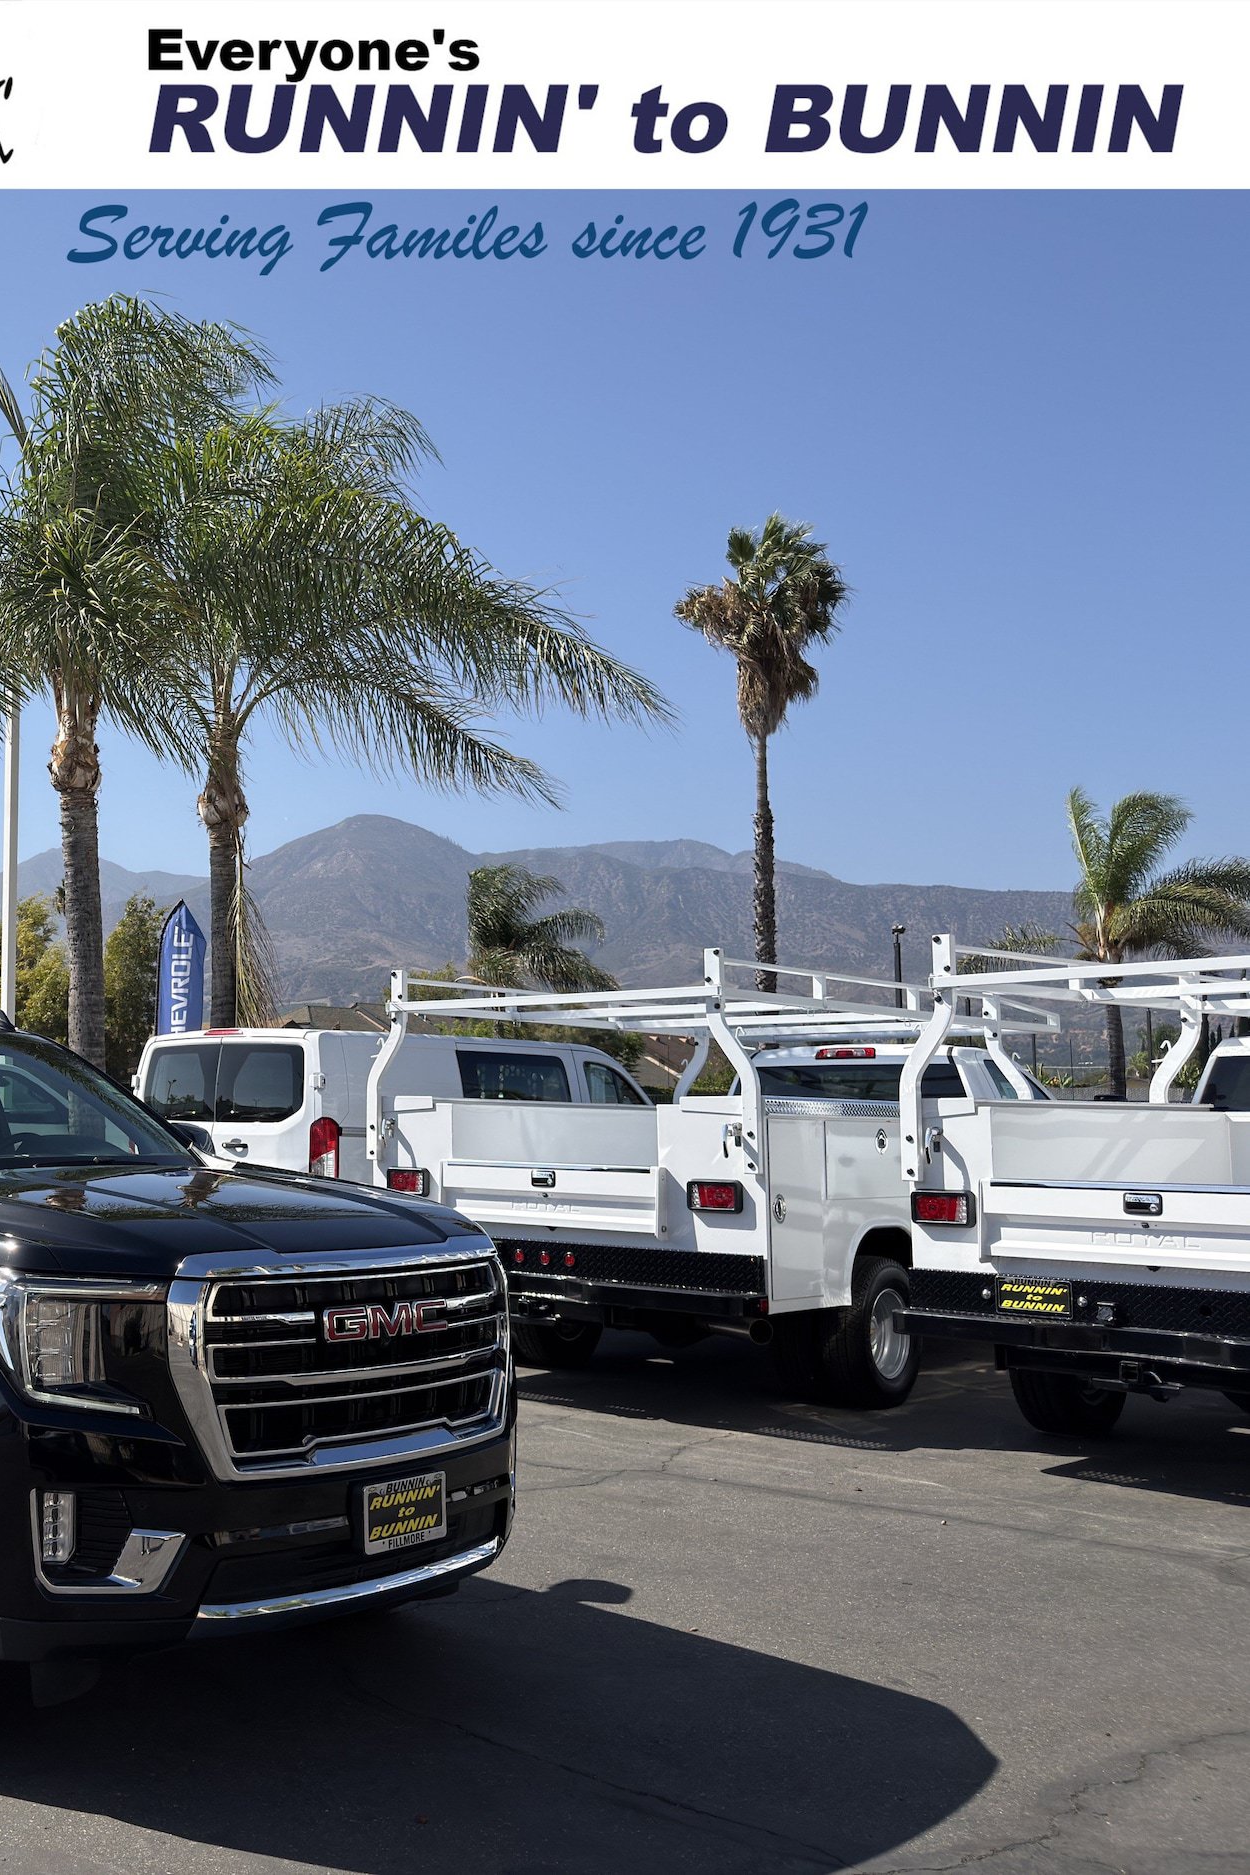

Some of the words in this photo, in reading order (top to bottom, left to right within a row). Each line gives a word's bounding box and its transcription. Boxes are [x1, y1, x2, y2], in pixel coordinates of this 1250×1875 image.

[1000, 1283, 1068, 1296] RUNNIN'
[1001, 1299, 1066, 1312] BUNNIN
[323, 1299, 448, 1343] GMC
[386, 1476, 427, 1493] BUNNIN
[369, 1484, 440, 1511] RUNNIN'
[397, 1506, 416, 1518] to
[369, 1513, 438, 1541] BUNNIN
[388, 1531, 425, 1549] FILLMORE
